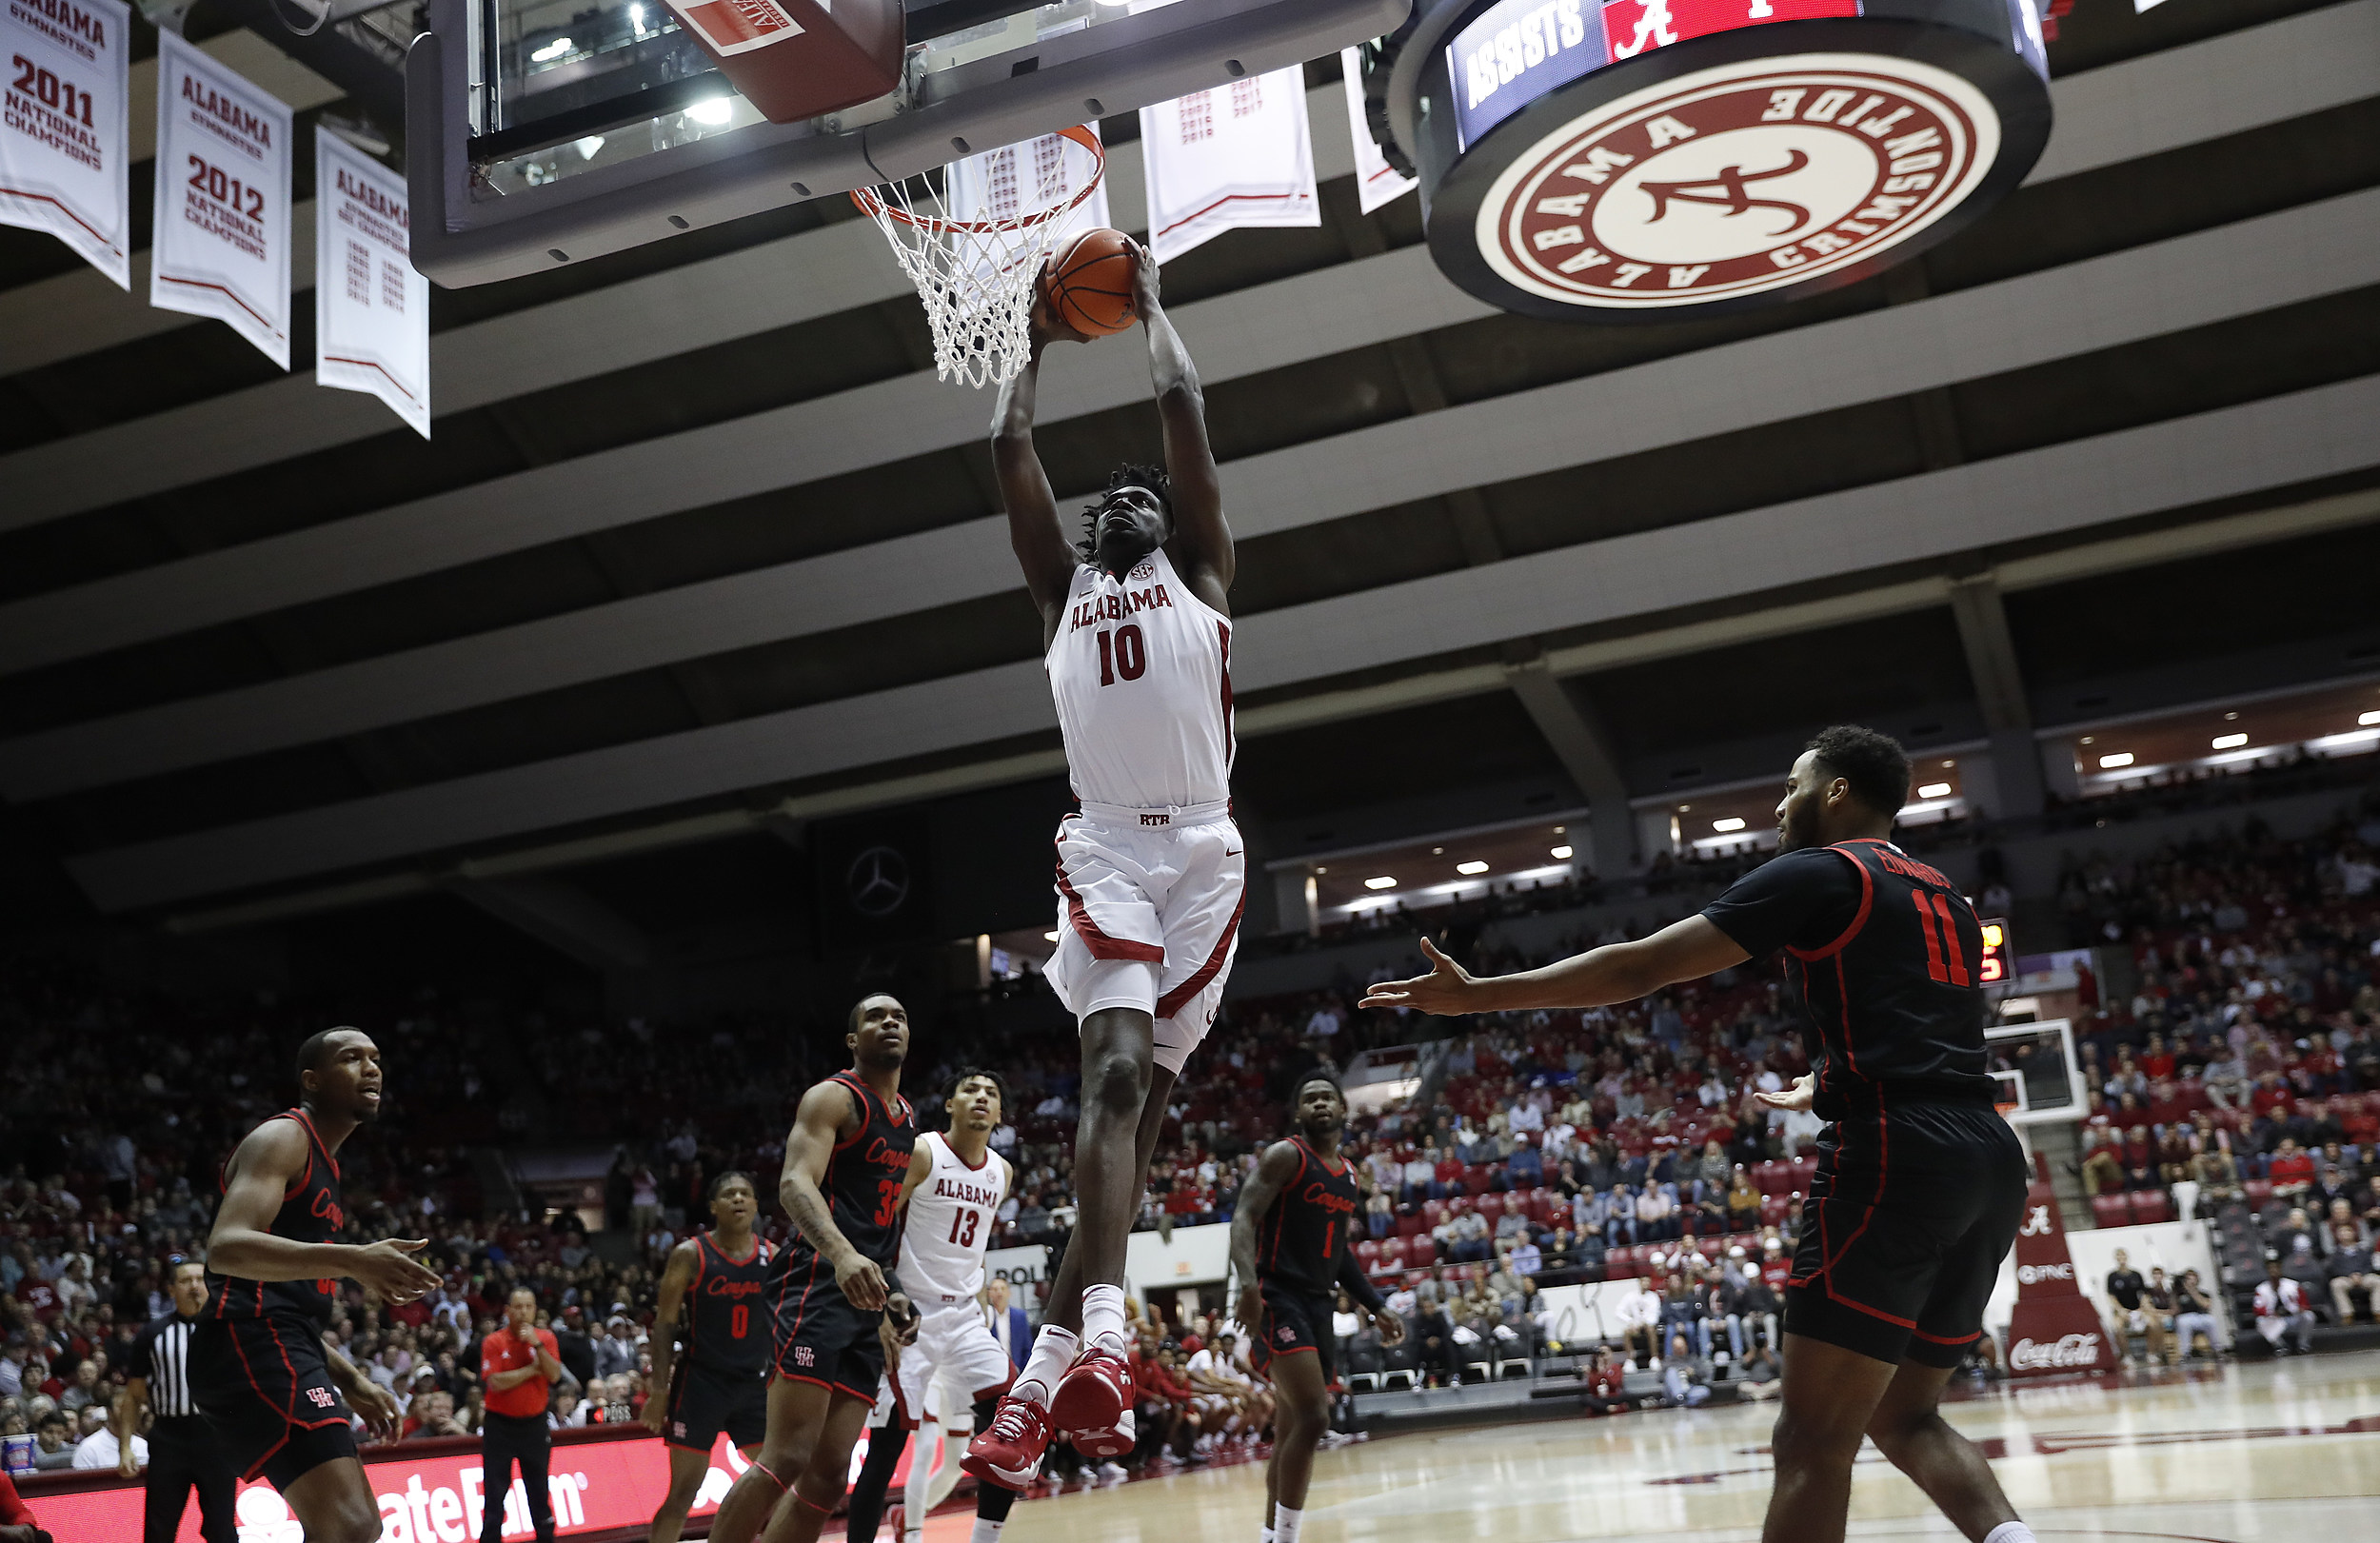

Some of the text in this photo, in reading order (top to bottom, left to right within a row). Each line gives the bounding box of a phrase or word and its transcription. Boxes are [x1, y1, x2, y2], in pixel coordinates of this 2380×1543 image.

[1467, 2, 1585, 110] ASSISTS
[6, 90, 102, 153] NATIONAL
[12, 54, 94, 129] 2011
[183, 74, 271, 148] ALABAMA
[1761, 88, 1915, 140] TIDE
[5, 110, 102, 171] CHAMPIONS
[187, 189, 267, 246] NATIONAL
[189, 154, 265, 224] 2012
[1534, 113, 1711, 289] ALABAMA
[1769, 125, 1946, 269] CRIMSON
[185, 207, 267, 262] CHAMPIONS
[1131, 564, 1154, 579] SEC
[1070, 584, 1172, 633] ALABAMA
[1097, 623, 1146, 687] 10
[1140, 814, 1170, 825] RTR
[1912, 888, 1970, 987] 11
[949, 1207, 980, 1248] 13
[1323, 1221, 1335, 1258] 1
[731, 1304, 749, 1339] 0
